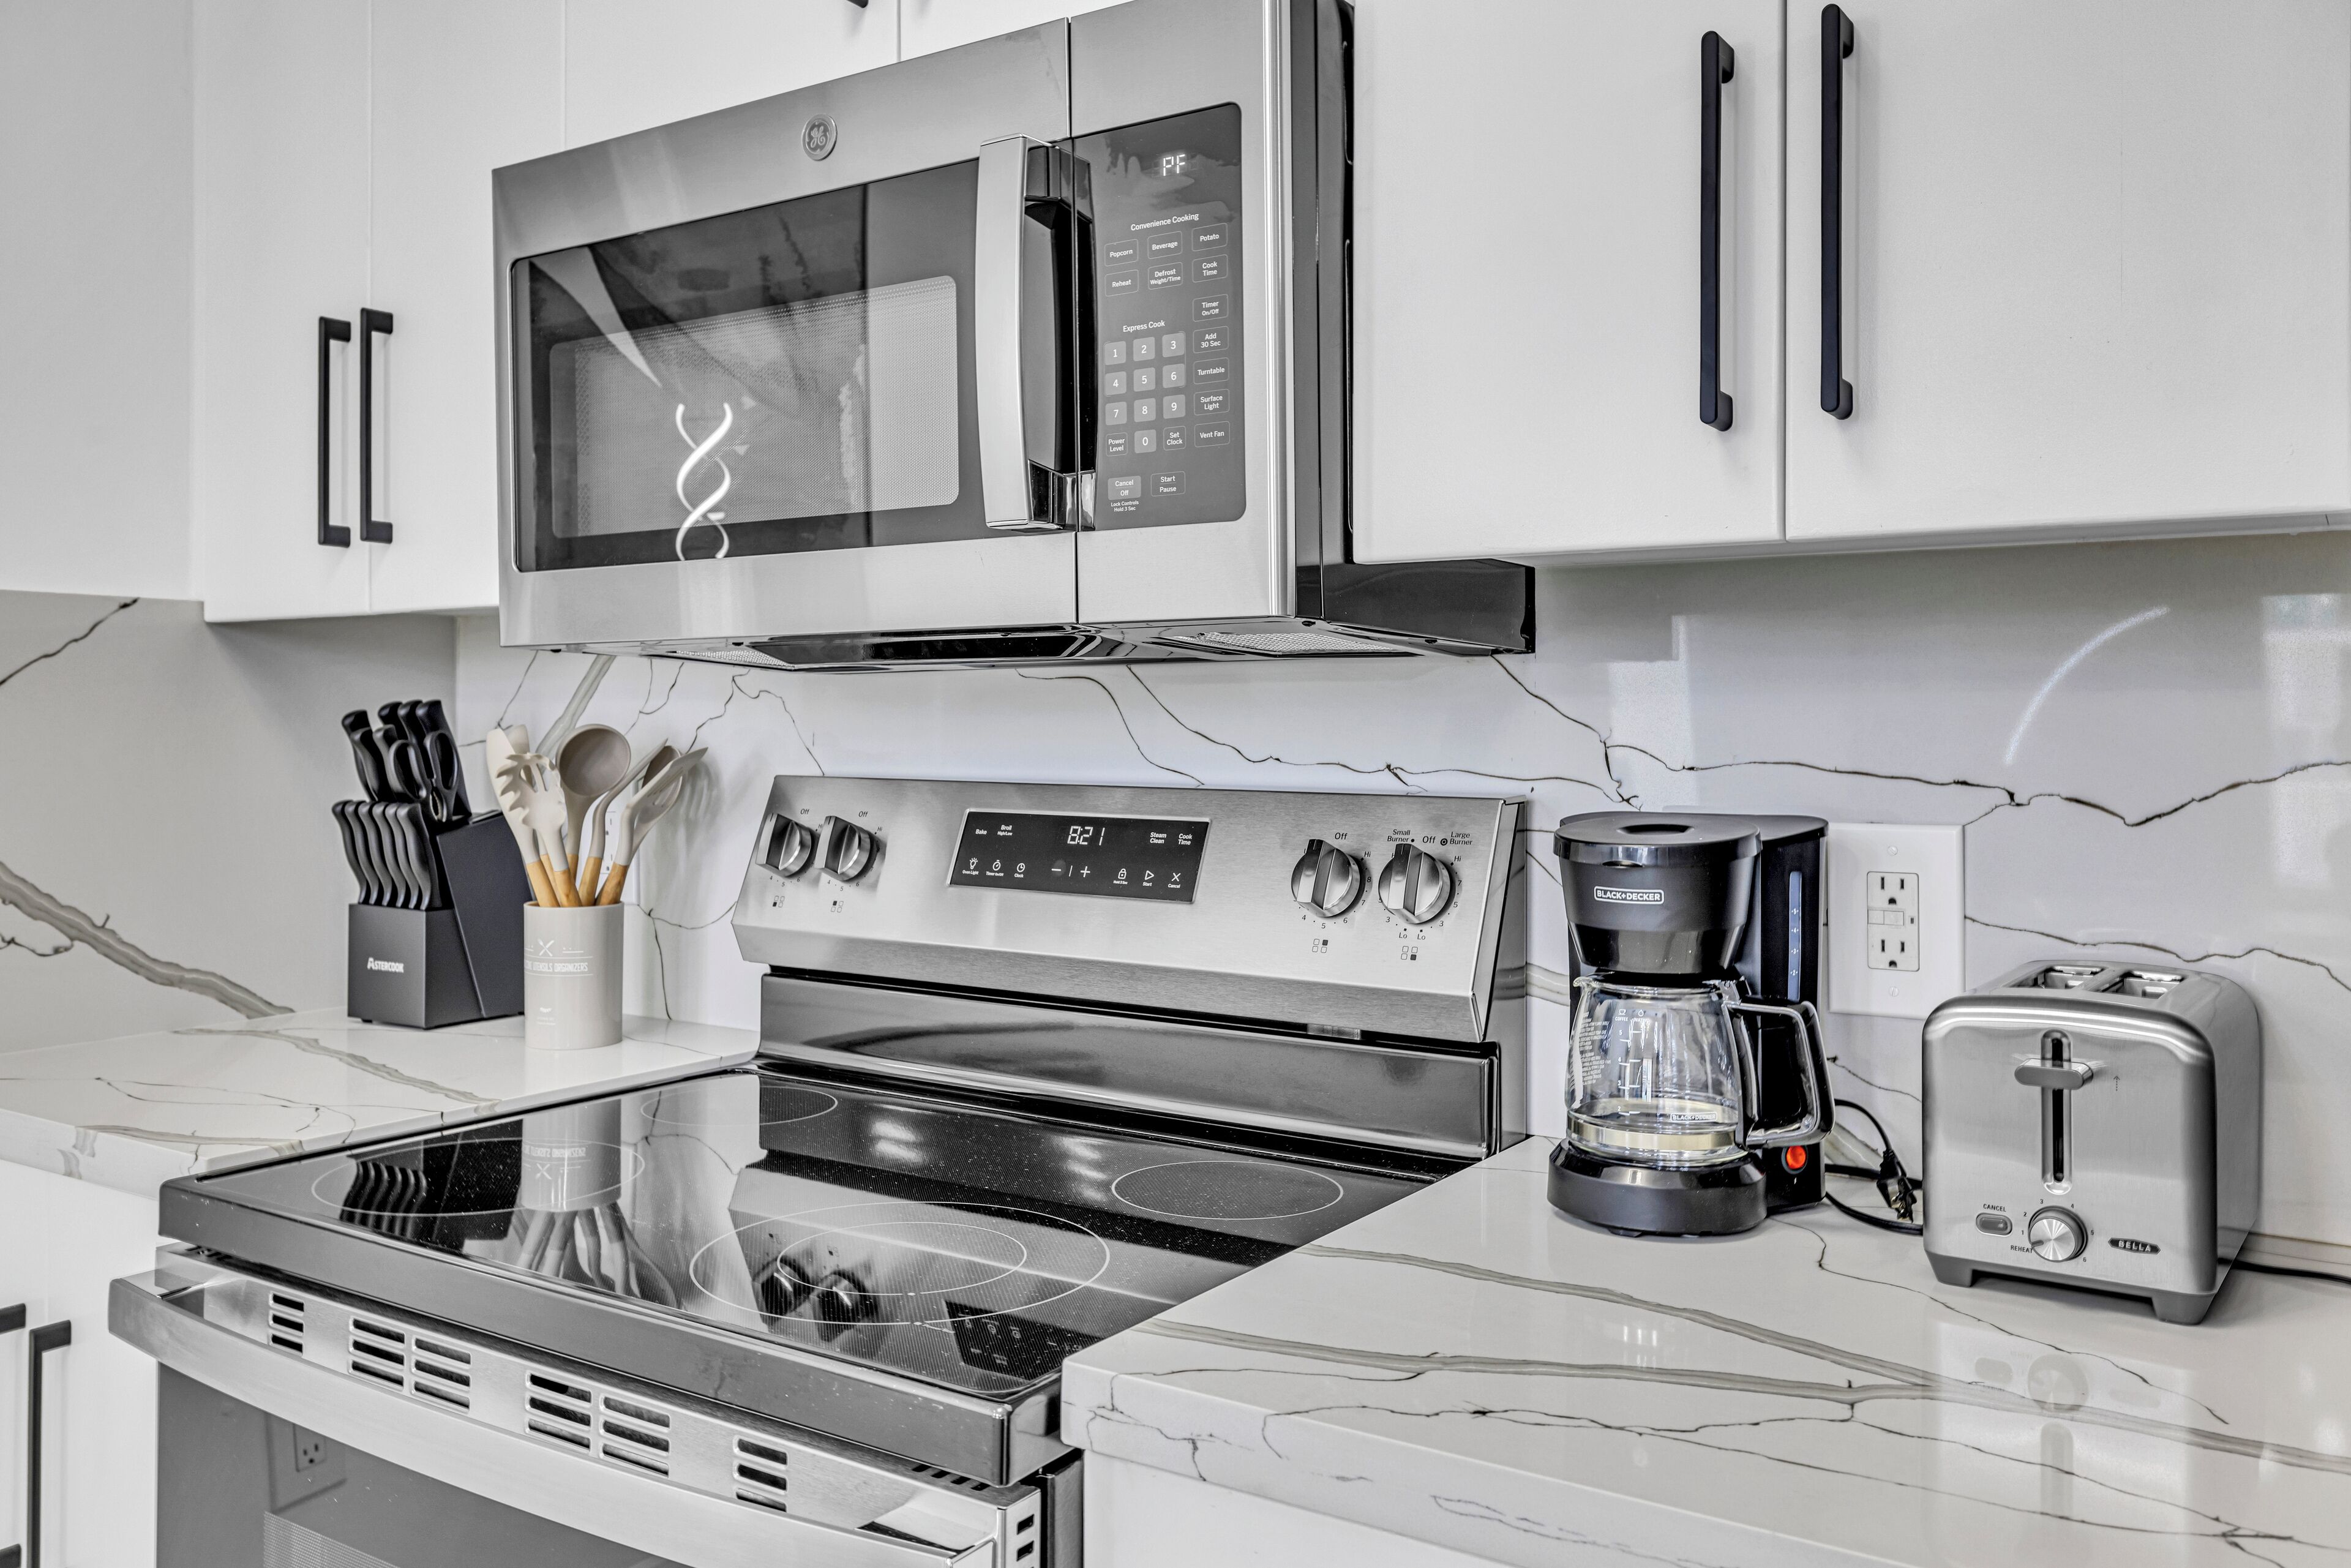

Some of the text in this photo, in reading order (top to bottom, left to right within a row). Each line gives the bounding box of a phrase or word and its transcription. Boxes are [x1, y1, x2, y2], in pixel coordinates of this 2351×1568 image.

[1163, 154, 1185, 176] PF
[1131, 213, 1199, 231] Convenience Cooking
[1200, 233, 1219, 242] Potato
[1152, 241, 1178, 251] Beverage
[1110, 249, 1133, 258] Popcorn
[1155, 269, 1176, 277] Defrost
[1150, 276, 1180, 285] Weight/Time
[1123, 323, 1147, 332] Express
[1171, 341, 1176, 350] 3
[1198, 367, 1225, 375] Turntable
[1142, 375, 1147, 384] 5
[1142, 406, 1147, 415] 8
[1171, 402, 1177, 411] 9
[1142, 437, 1148, 446] 0
[1067, 826, 1105, 846] 8:21
[1597, 890, 1660, 901] BLACK+DECKER
[1983, 1204, 2006, 1212] CANCEL
[2011, 1245, 2033, 1254] REHEAT
[2118, 1240, 2151, 1252] BELLA
